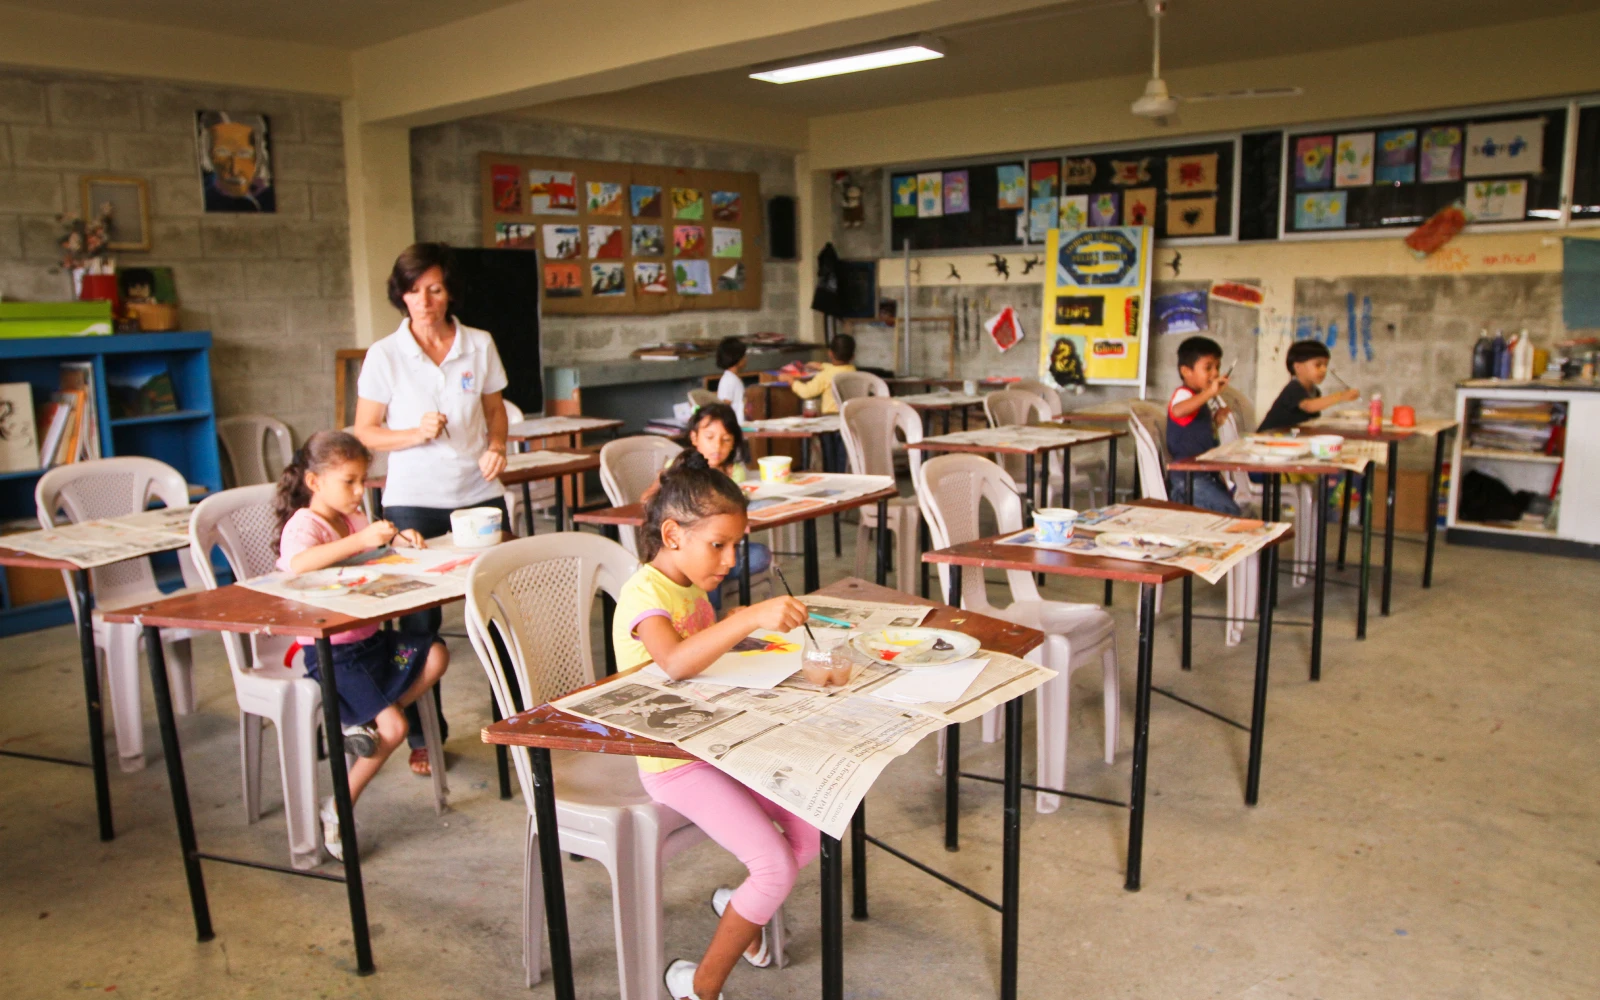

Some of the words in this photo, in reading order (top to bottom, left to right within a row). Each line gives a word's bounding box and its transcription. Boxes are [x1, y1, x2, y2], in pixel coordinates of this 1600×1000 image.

[827, 757, 847, 779] muestra
[836, 768, 849, 781] feria
[807, 778, 828, 811] proyectos
[824, 781, 838, 799] Socio
